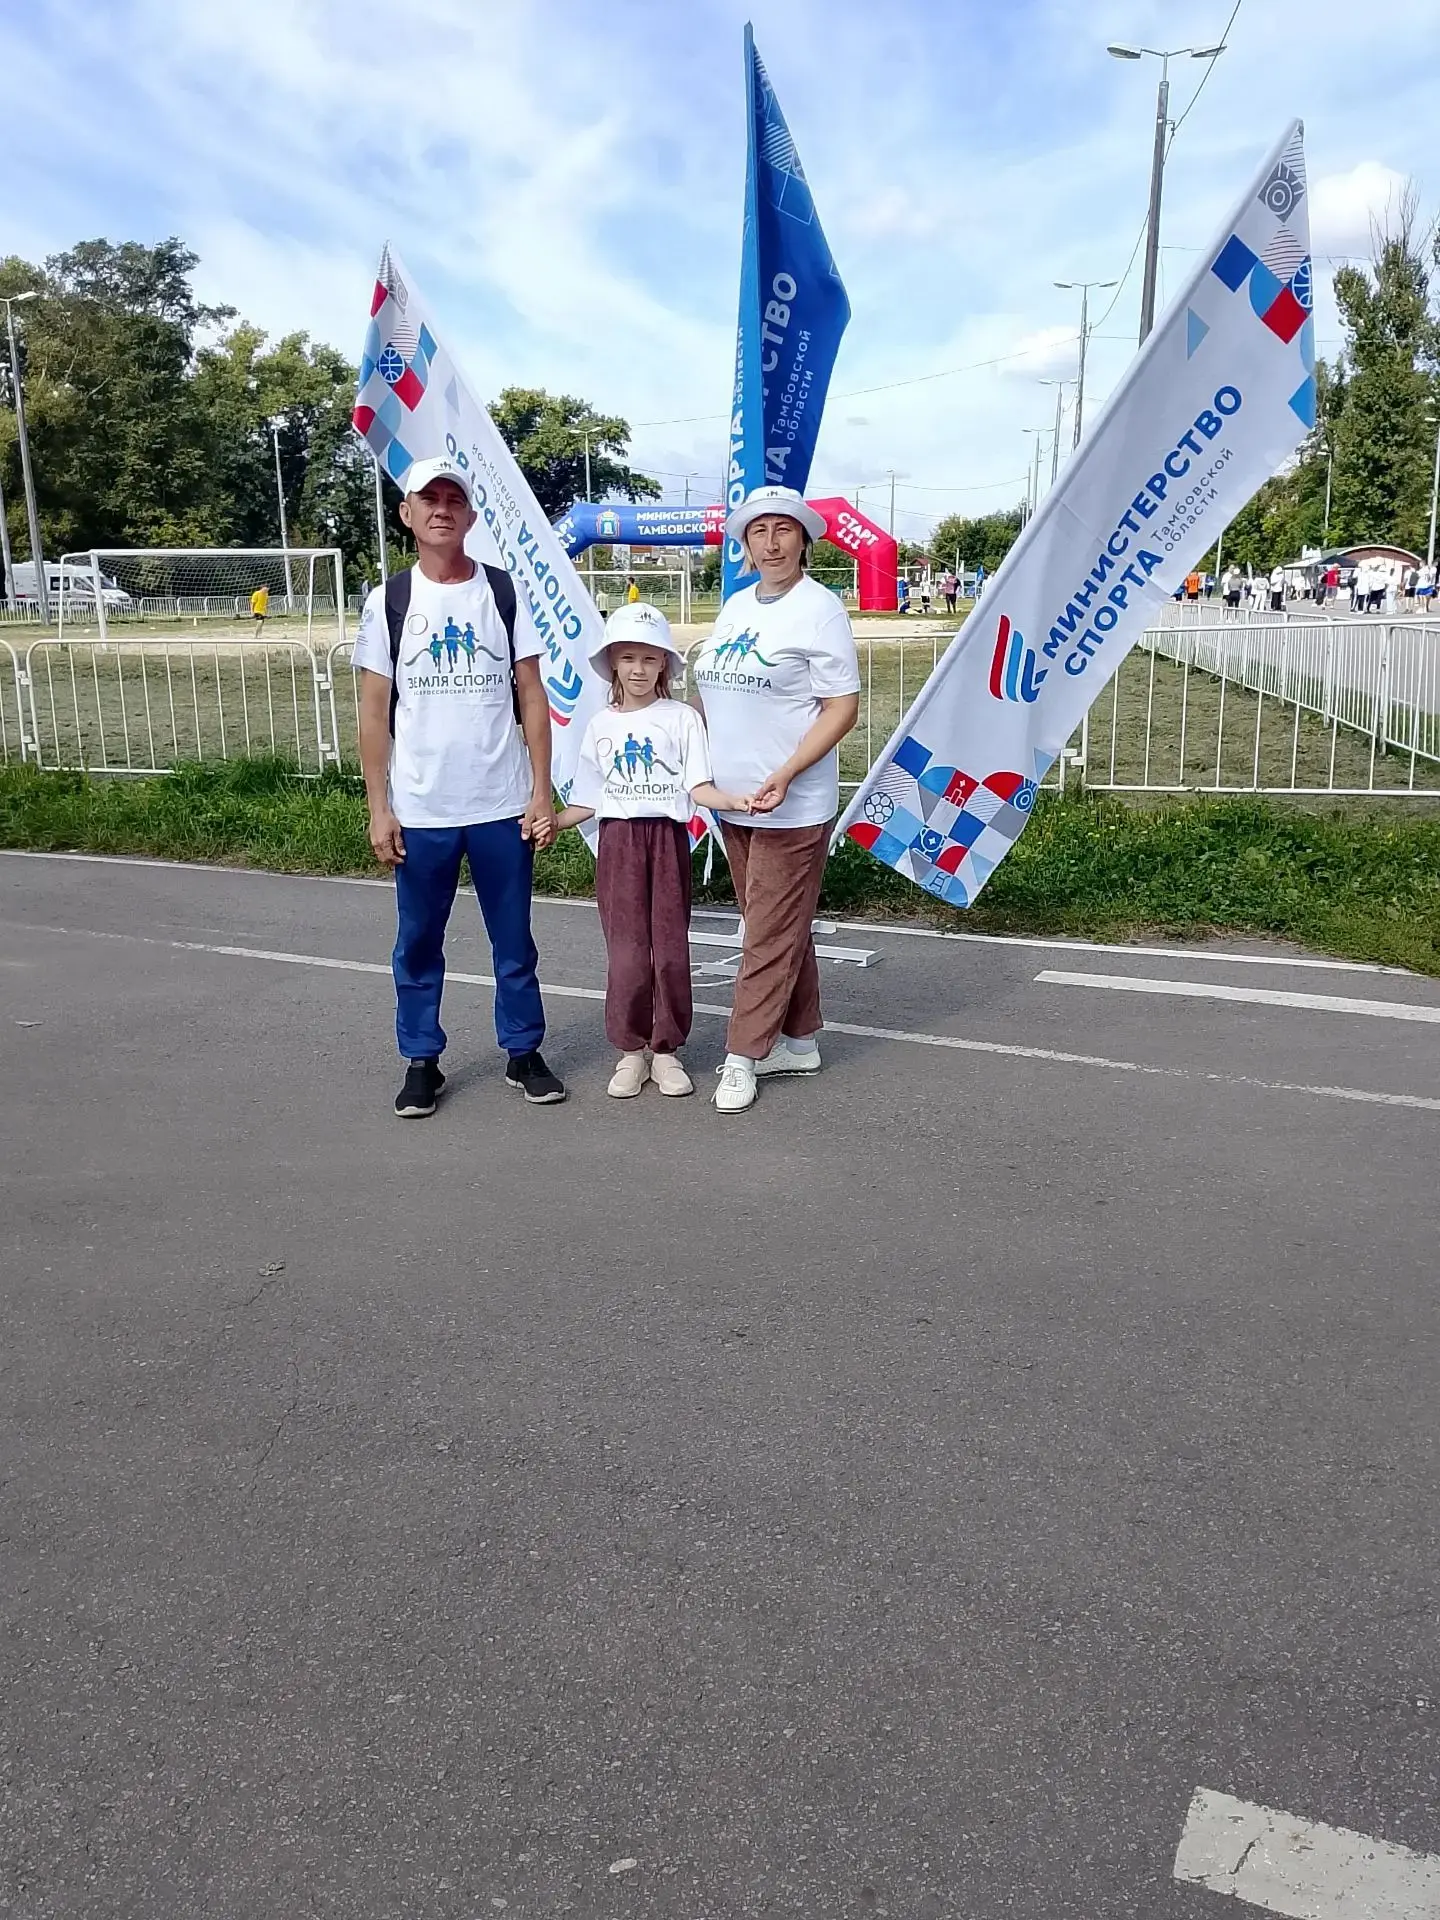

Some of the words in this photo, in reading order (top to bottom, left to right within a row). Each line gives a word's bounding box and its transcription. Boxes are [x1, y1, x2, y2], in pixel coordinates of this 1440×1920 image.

[771, 330, 811, 435] Тамбовской
[787, 370, 814, 441] области
[728, 409, 745, 563] СОРТА
[1042, 385, 1242, 659] МИНИСТЕРСТВО
[1150, 447, 1234, 542] Тамбовской
[1164, 488, 1218, 552] области
[637, 521, 717, 535] ТАМБОВСКОЙ
[838, 512, 879, 546] СТАРТ
[517, 519, 582, 640] СПОРТА
[1065, 549, 1164, 676] СПОРТА
[407, 676, 449, 689] ЗЕМЛЯ
[453, 674, 504, 687] СПОРТА
[723, 673, 772, 689] СПОРТА
